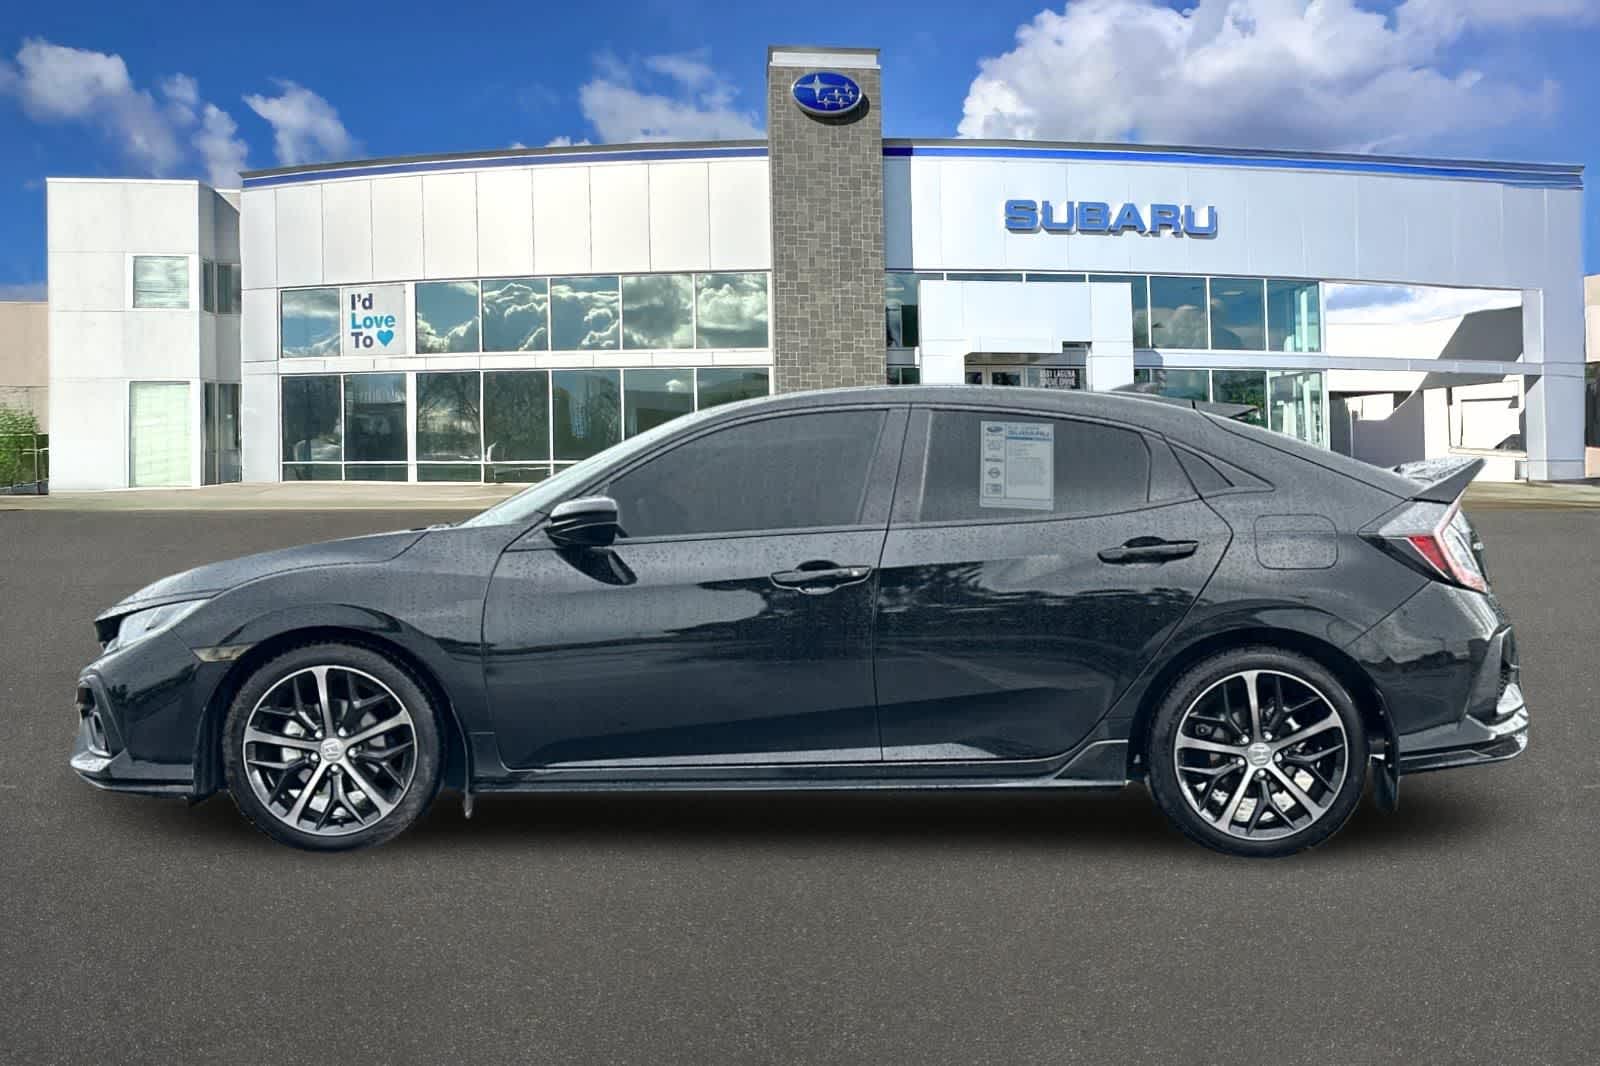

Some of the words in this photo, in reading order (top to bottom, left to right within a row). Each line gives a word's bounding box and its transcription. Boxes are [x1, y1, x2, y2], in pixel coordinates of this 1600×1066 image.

[1004, 199, 1217, 237] SUBARU
[350, 293, 373, 310] I'd
[351, 313, 396, 329] Love
[350, 332, 374, 348] To
